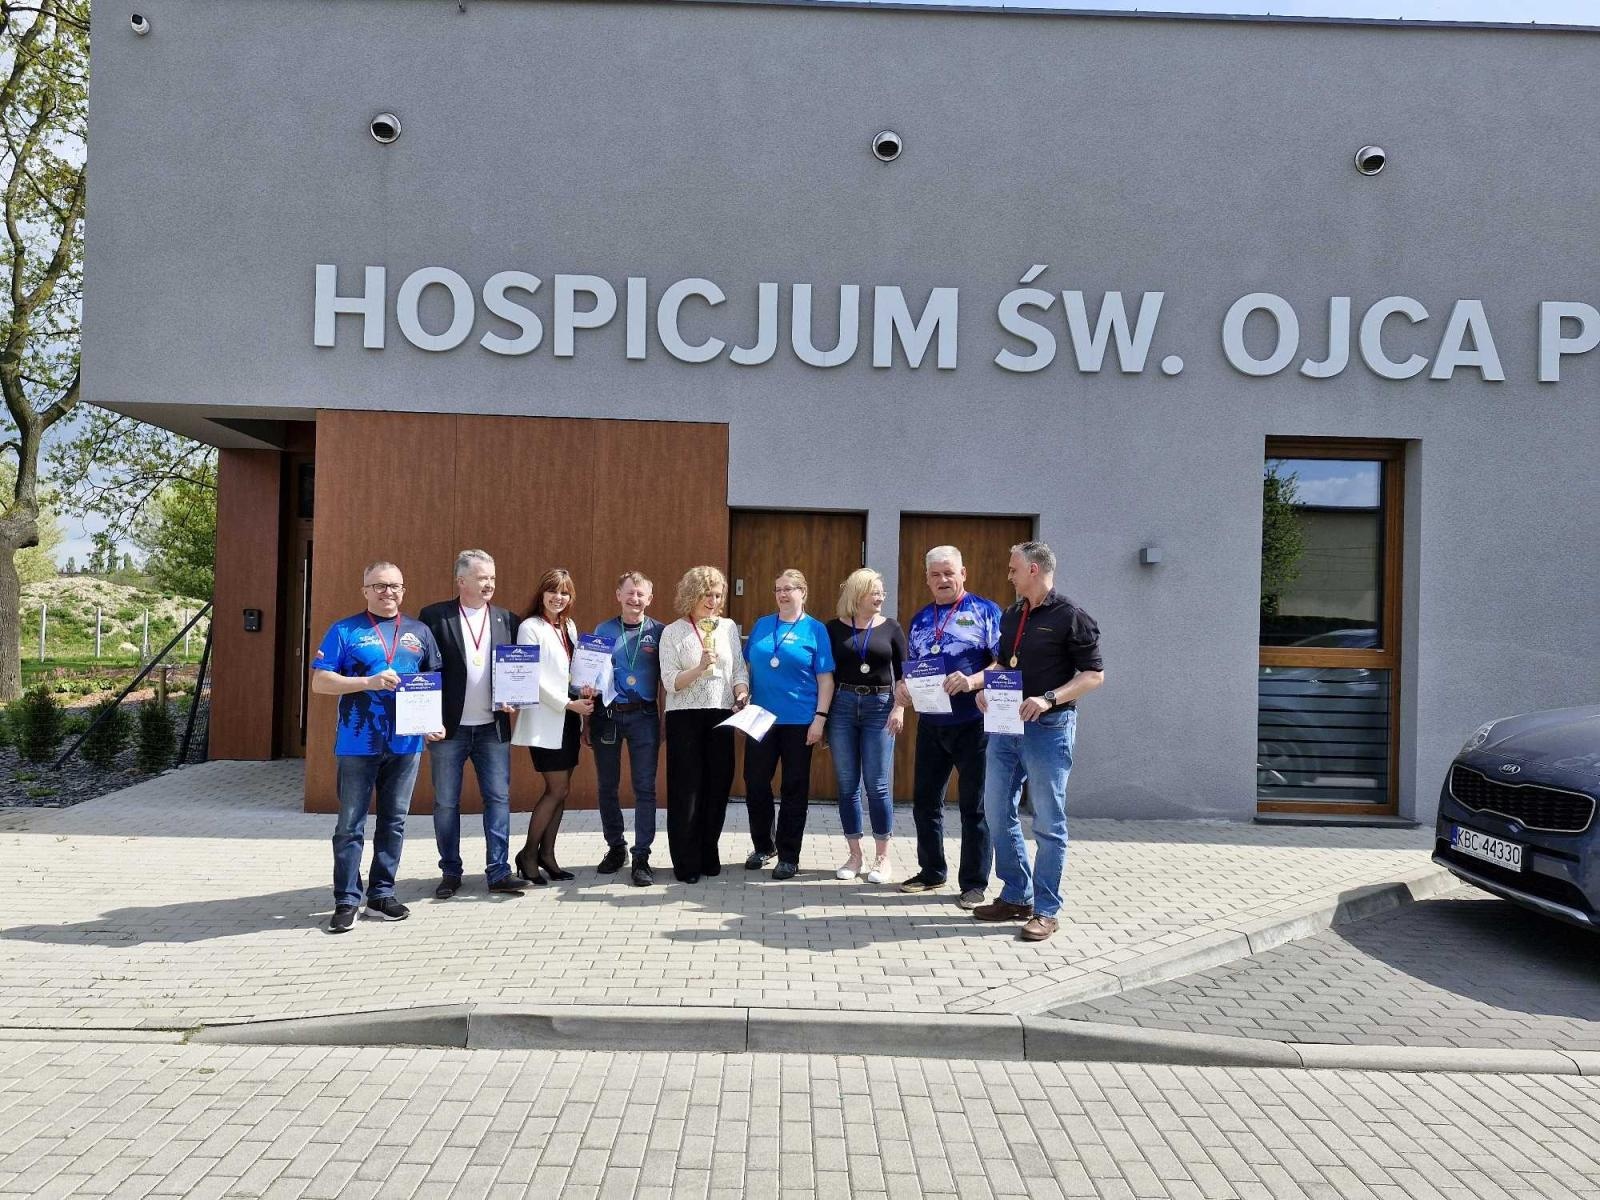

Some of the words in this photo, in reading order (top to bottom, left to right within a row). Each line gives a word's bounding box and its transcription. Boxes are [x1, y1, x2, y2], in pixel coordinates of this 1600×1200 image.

[314, 264, 959, 370] HOSPICJUM
[994, 264, 1184, 376] ŚW.
[1222, 292, 1506, 382] OJCA
[1457, 828, 1478, 851] KBC
[1482, 838, 1520, 865] 44330
